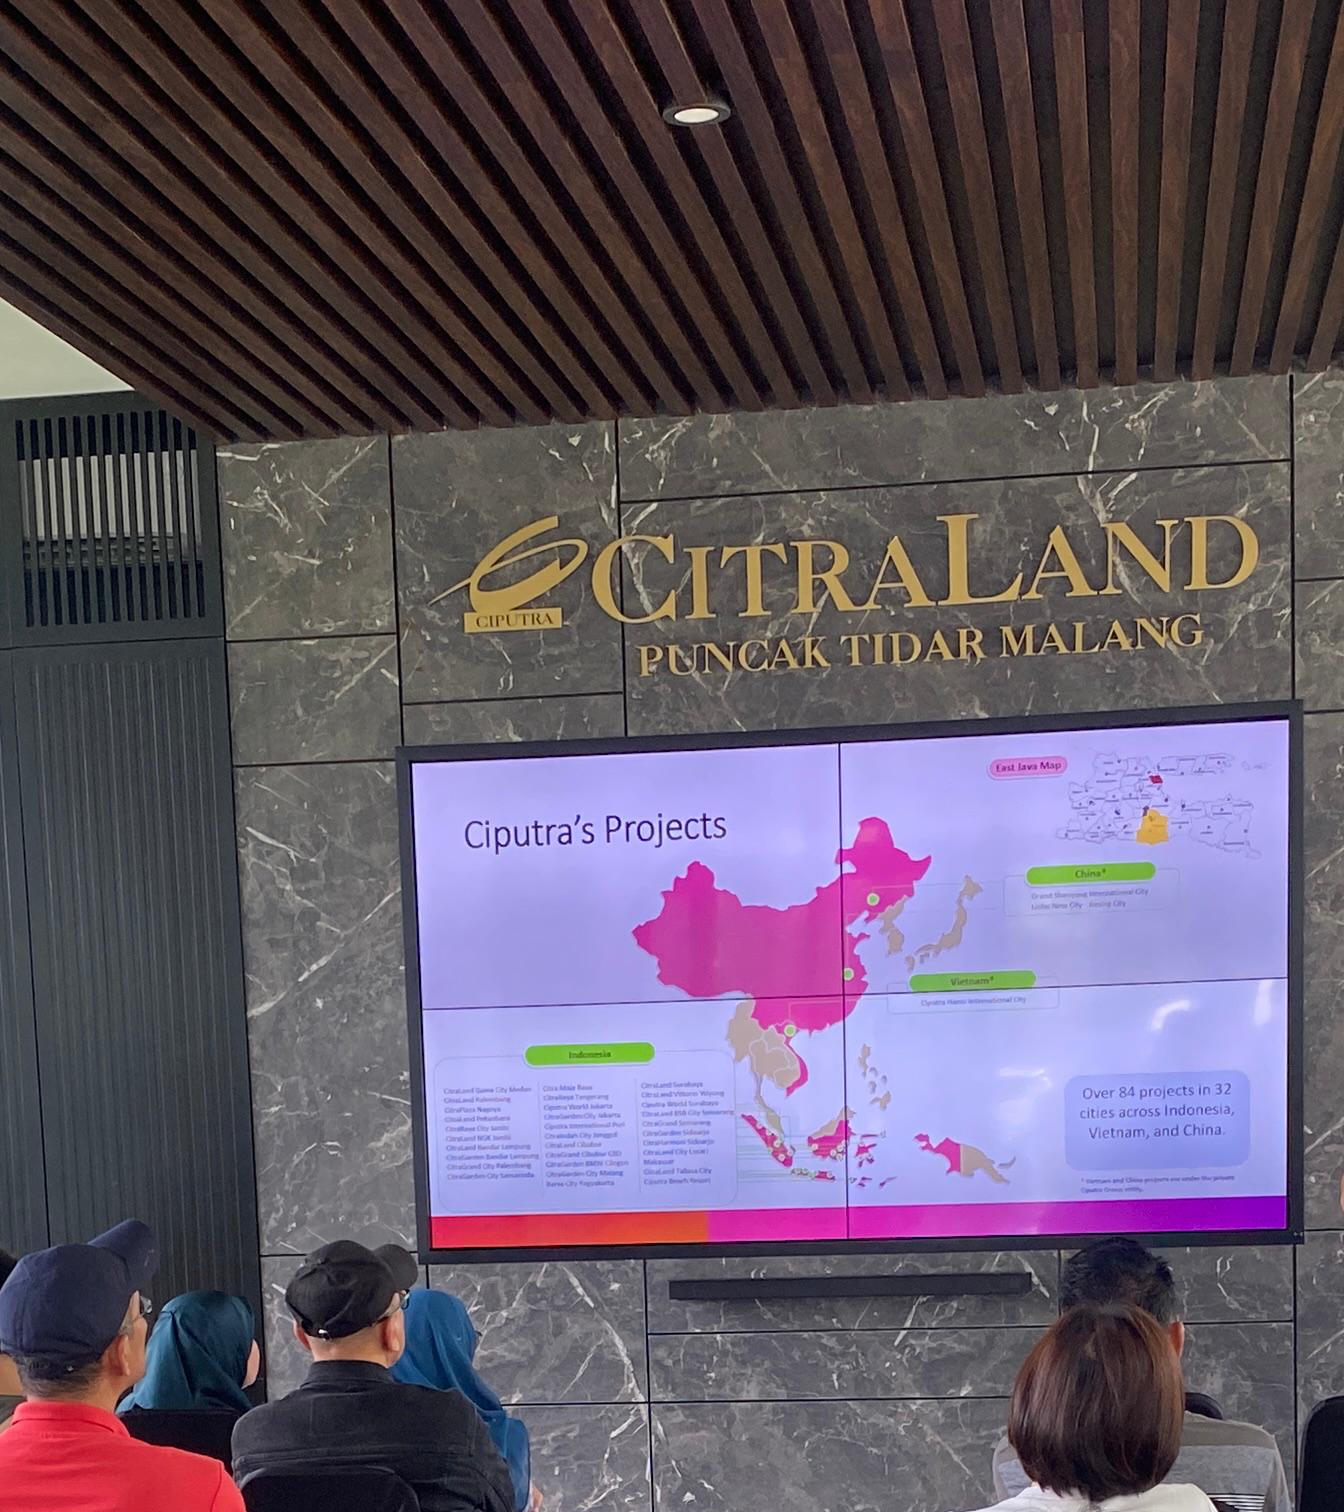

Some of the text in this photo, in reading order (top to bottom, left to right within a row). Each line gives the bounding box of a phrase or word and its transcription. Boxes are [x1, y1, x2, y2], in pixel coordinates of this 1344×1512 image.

[476, 611, 554, 629] CIPUTRA
[639, 613, 1205, 678] PUNCAK TIDAR MALANG
[996, 761, 1062, 773] East Java Map
[465, 812, 727, 855] Ciputra’s Projects
[1082, 1082, 1232, 1100] Over 84 projects in 32
[1080, 1103, 1235, 1119] cities across Indonesia,
[1089, 1123, 1226, 1140] Vietnam, and China.
